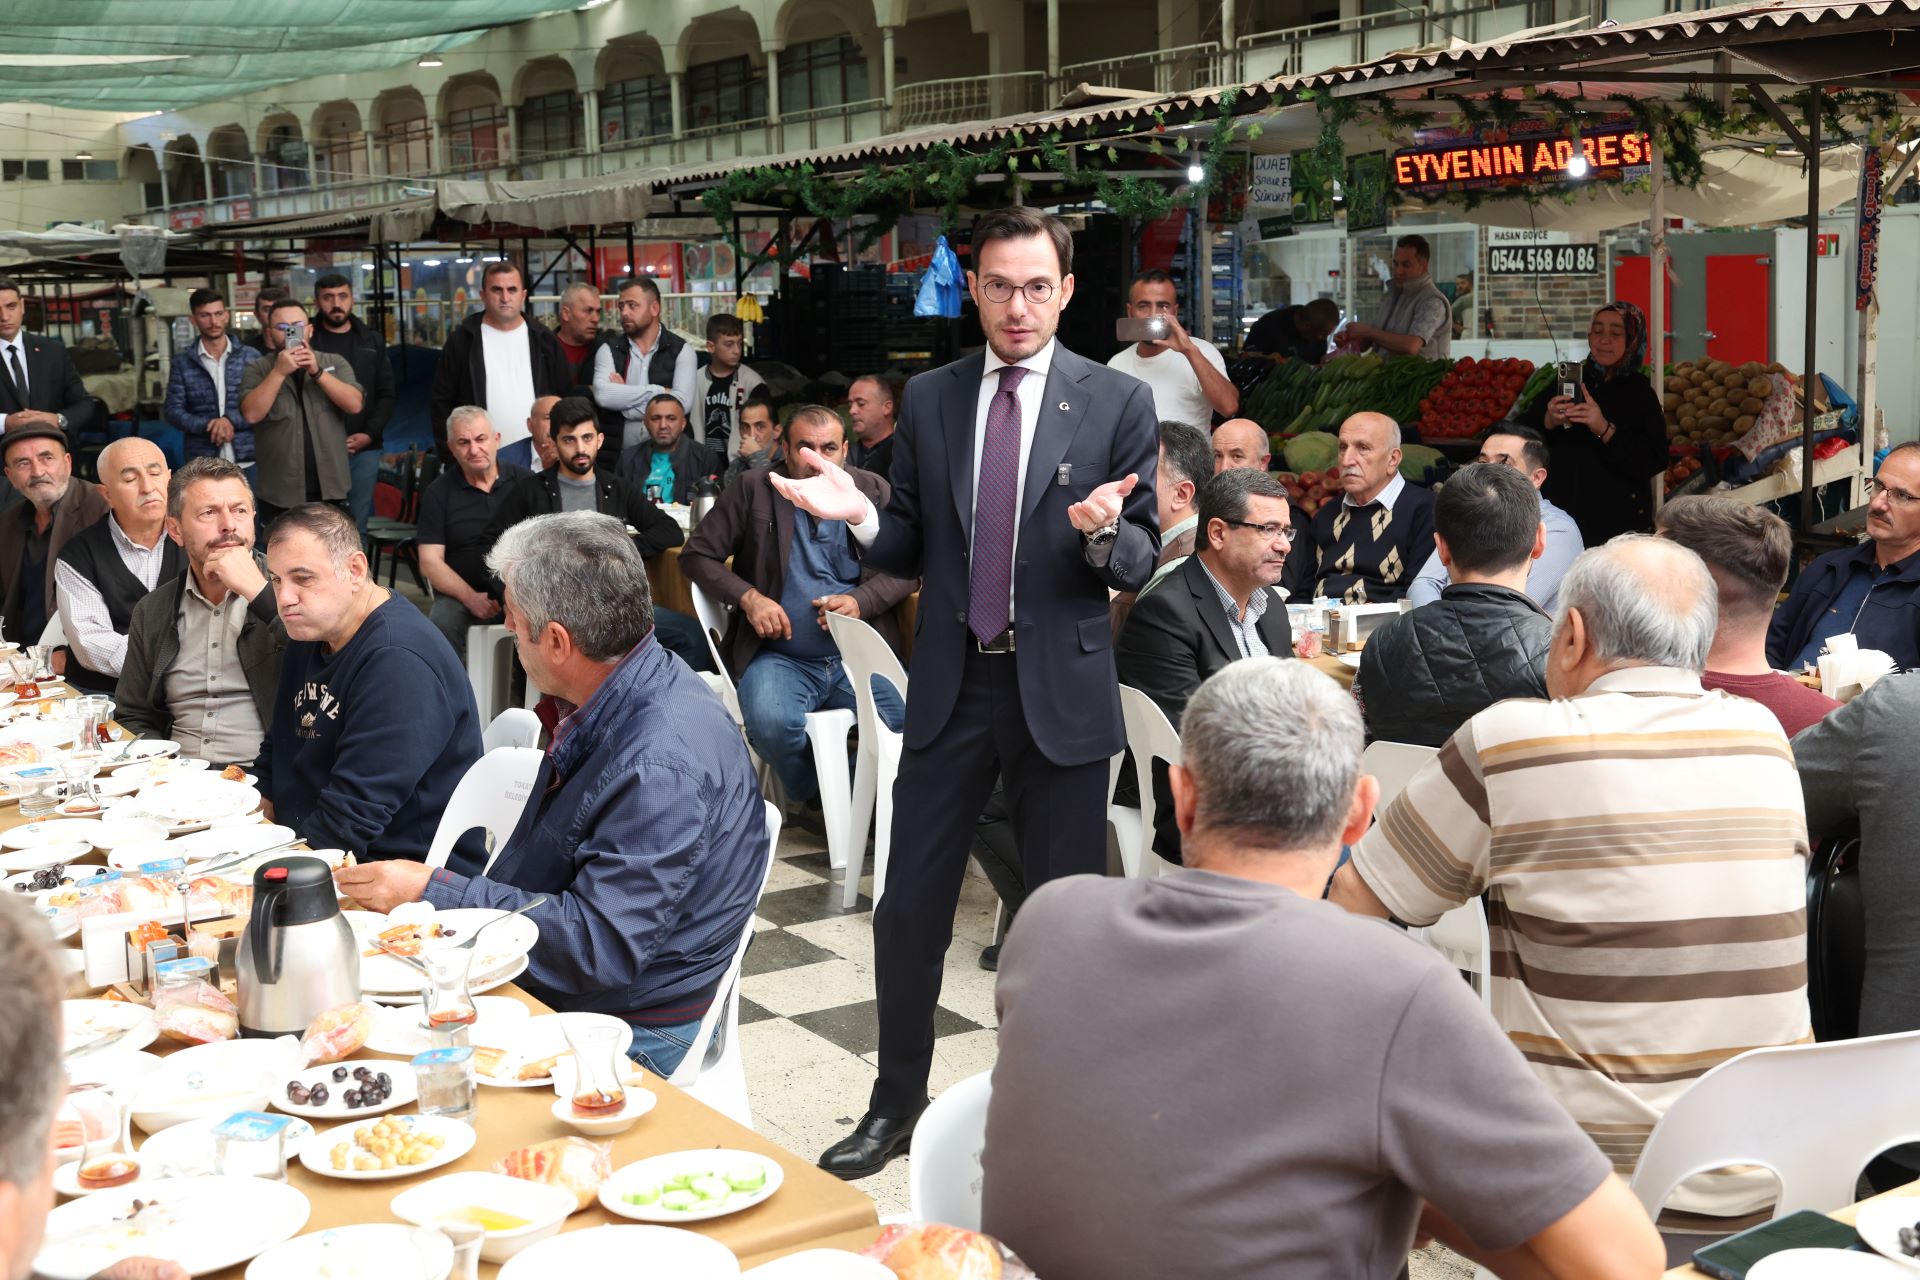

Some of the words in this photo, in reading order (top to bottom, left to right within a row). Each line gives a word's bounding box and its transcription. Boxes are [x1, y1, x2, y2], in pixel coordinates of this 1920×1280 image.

[1255, 157, 1278, 171] DUA
[1494, 231, 1520, 241] HASAN
[1491, 249, 1525, 272] 0544
[1527, 248, 1553, 271] 568
[1556, 247, 1574, 271] 60
[1577, 247, 1595, 271] 86
